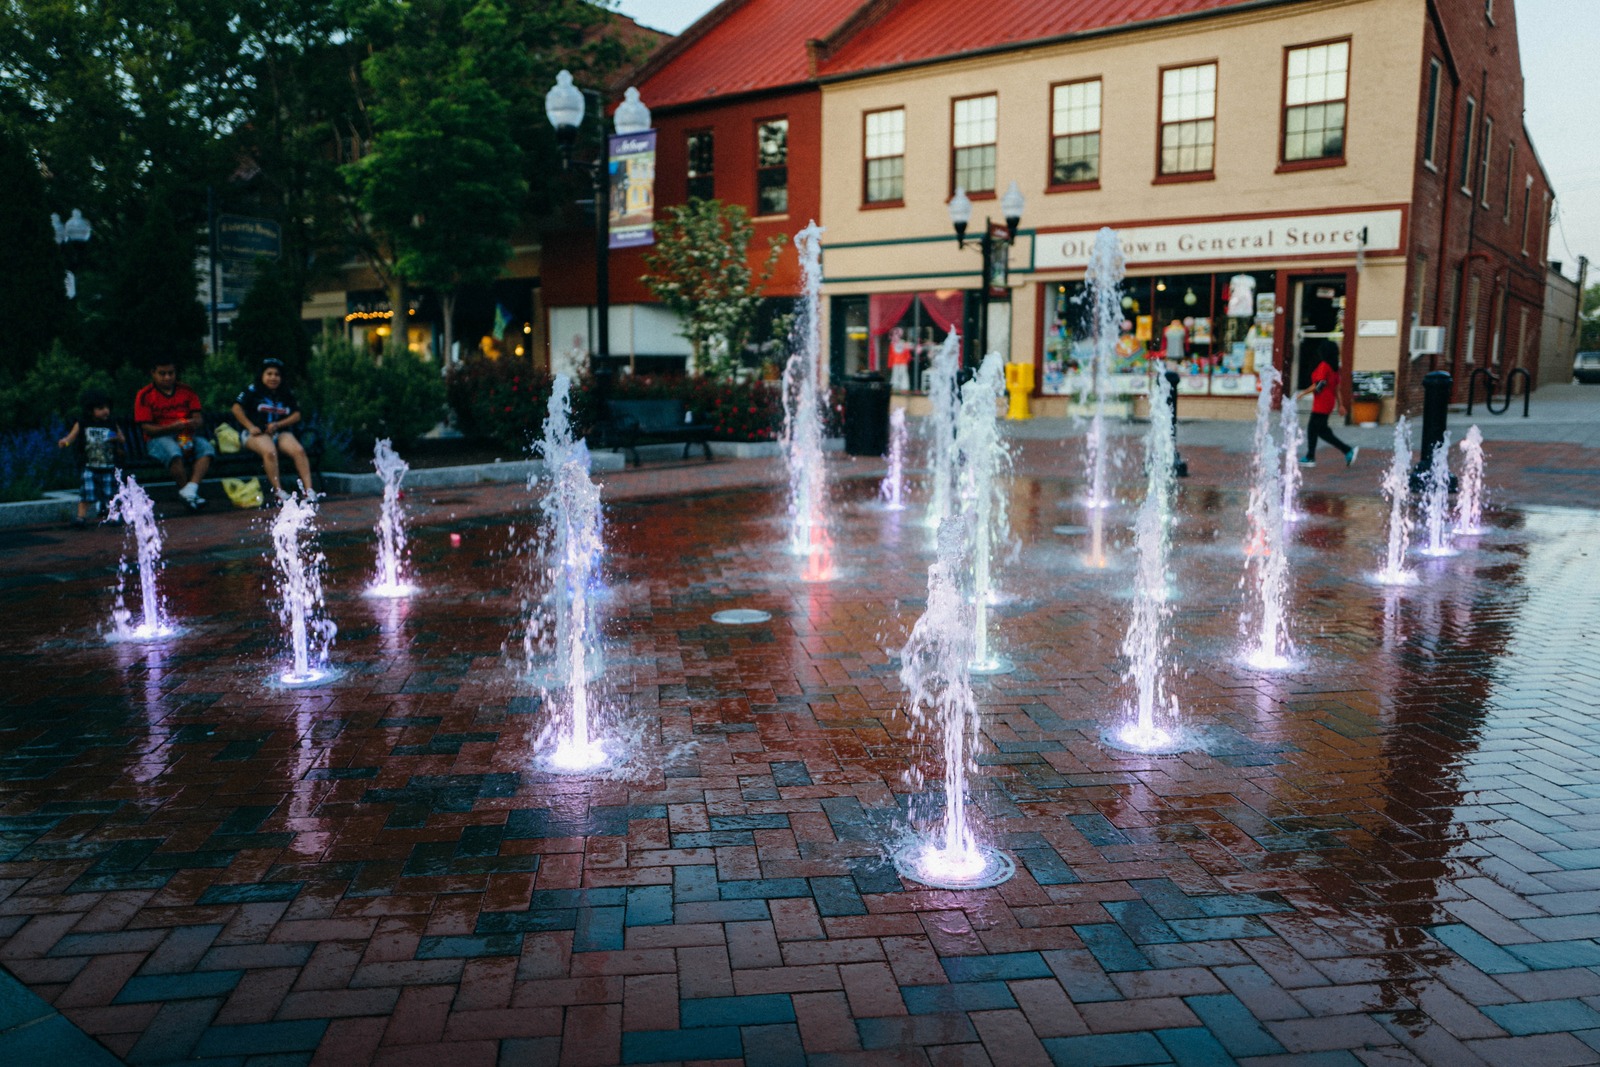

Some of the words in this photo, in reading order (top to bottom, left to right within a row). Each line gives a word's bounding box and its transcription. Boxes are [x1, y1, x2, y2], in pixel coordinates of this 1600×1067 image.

[1119, 237, 1168, 255] own
[1177, 229, 1275, 252] General
[1285, 226, 1355, 247] Store
